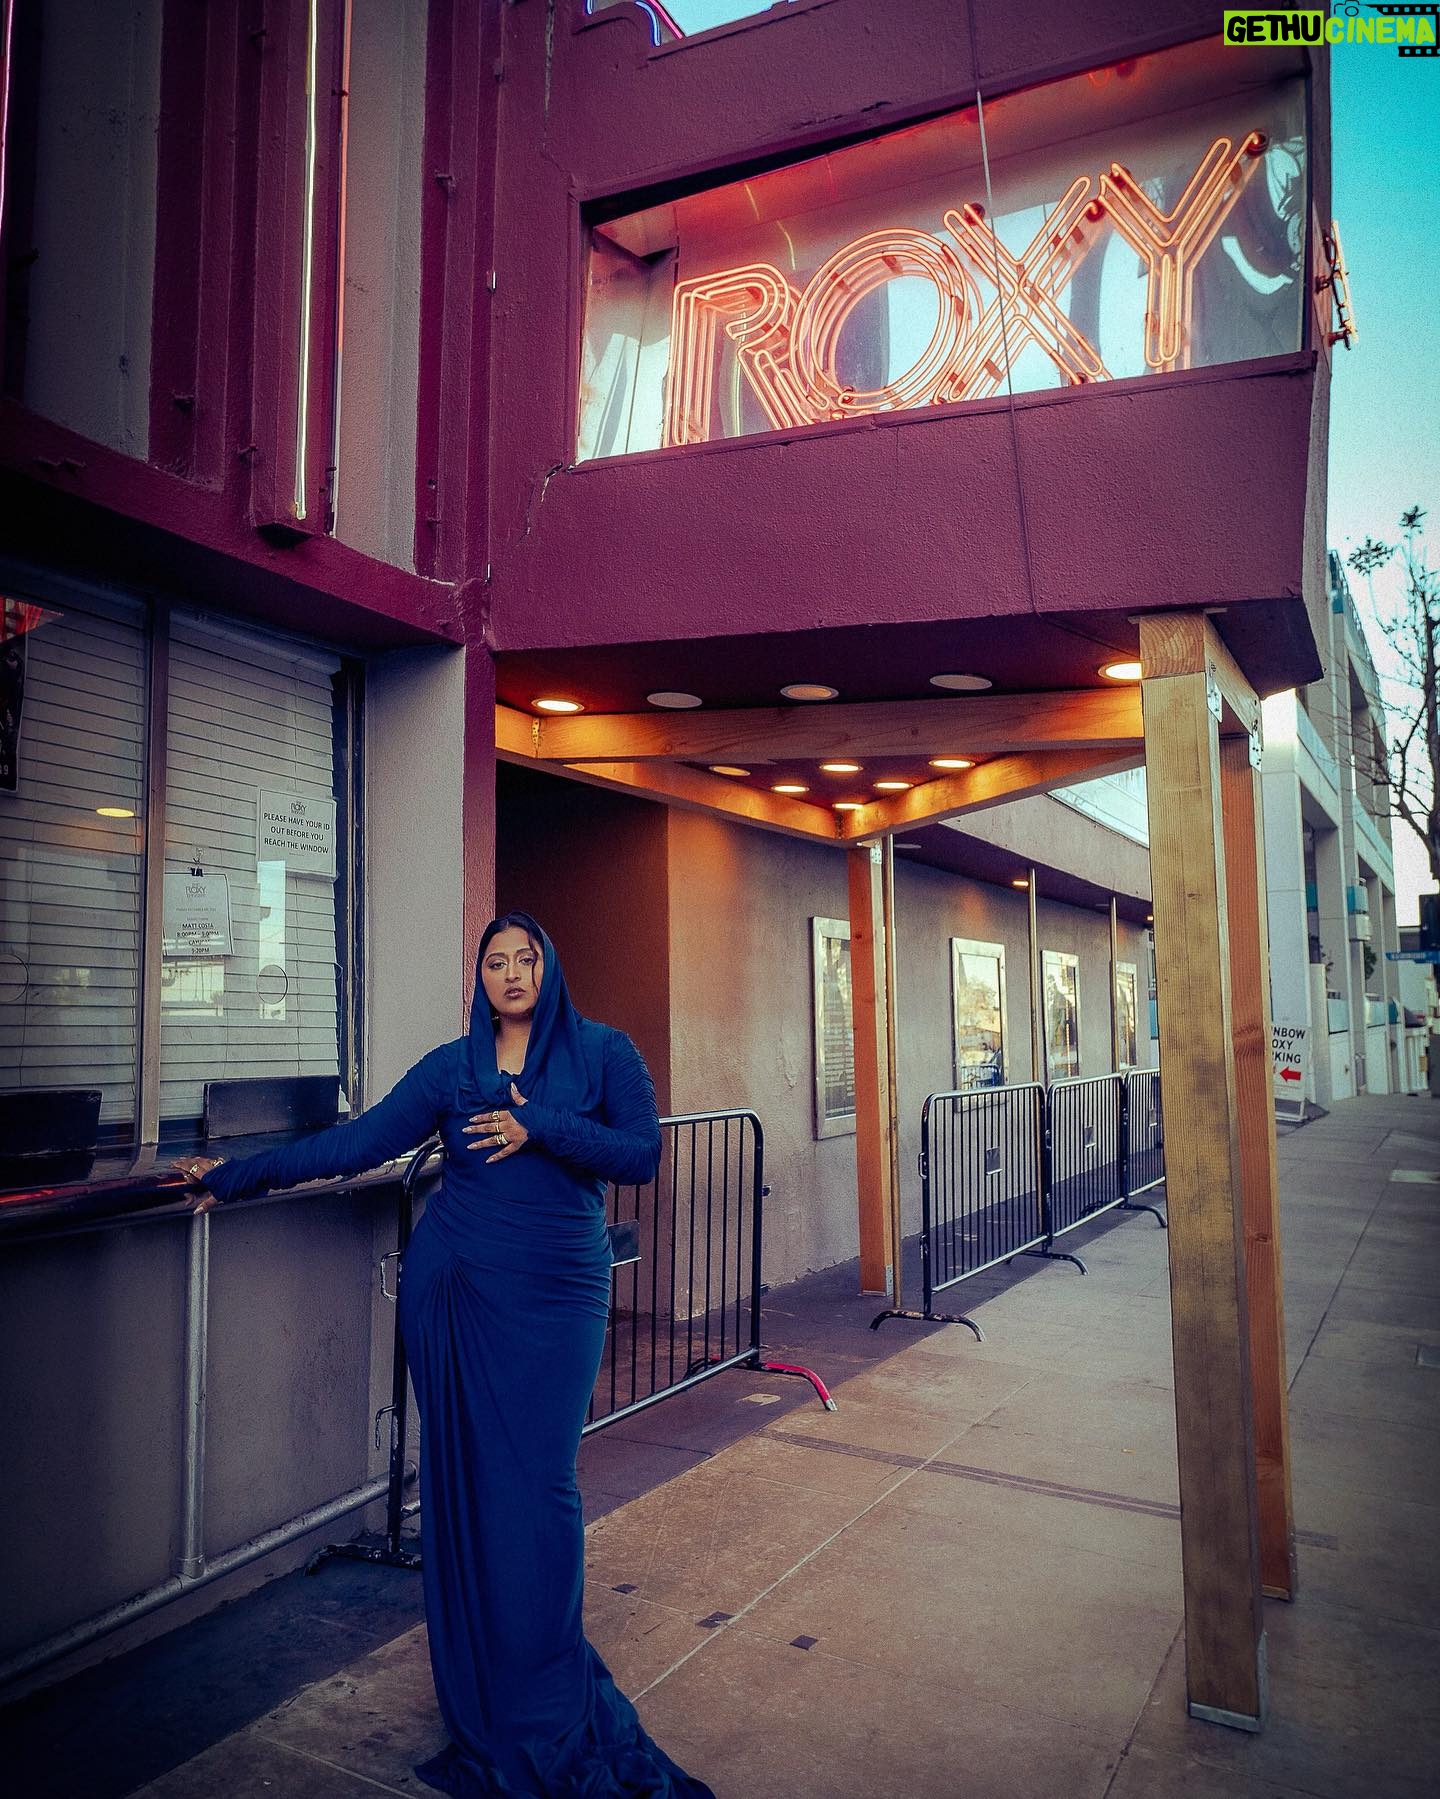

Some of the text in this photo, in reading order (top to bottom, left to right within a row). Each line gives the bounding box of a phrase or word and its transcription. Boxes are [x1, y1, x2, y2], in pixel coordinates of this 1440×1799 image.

[669, 128, 1267, 447] ROXY
[263, 812, 287, 823] PLEASE
[288, 817, 304, 826] HAVE
[306, 820, 323, 829] YOUR
[323, 823, 330, 831] ID
[270, 826, 324, 841] OUT BEFORE YOU
[264, 837, 329, 854] REACH THE WINDOW
[1272, 1026, 1306, 1040] NBOW
[1271, 1038, 1293, 1050] OXY
[1273, 1051, 1302, 1064] KING
